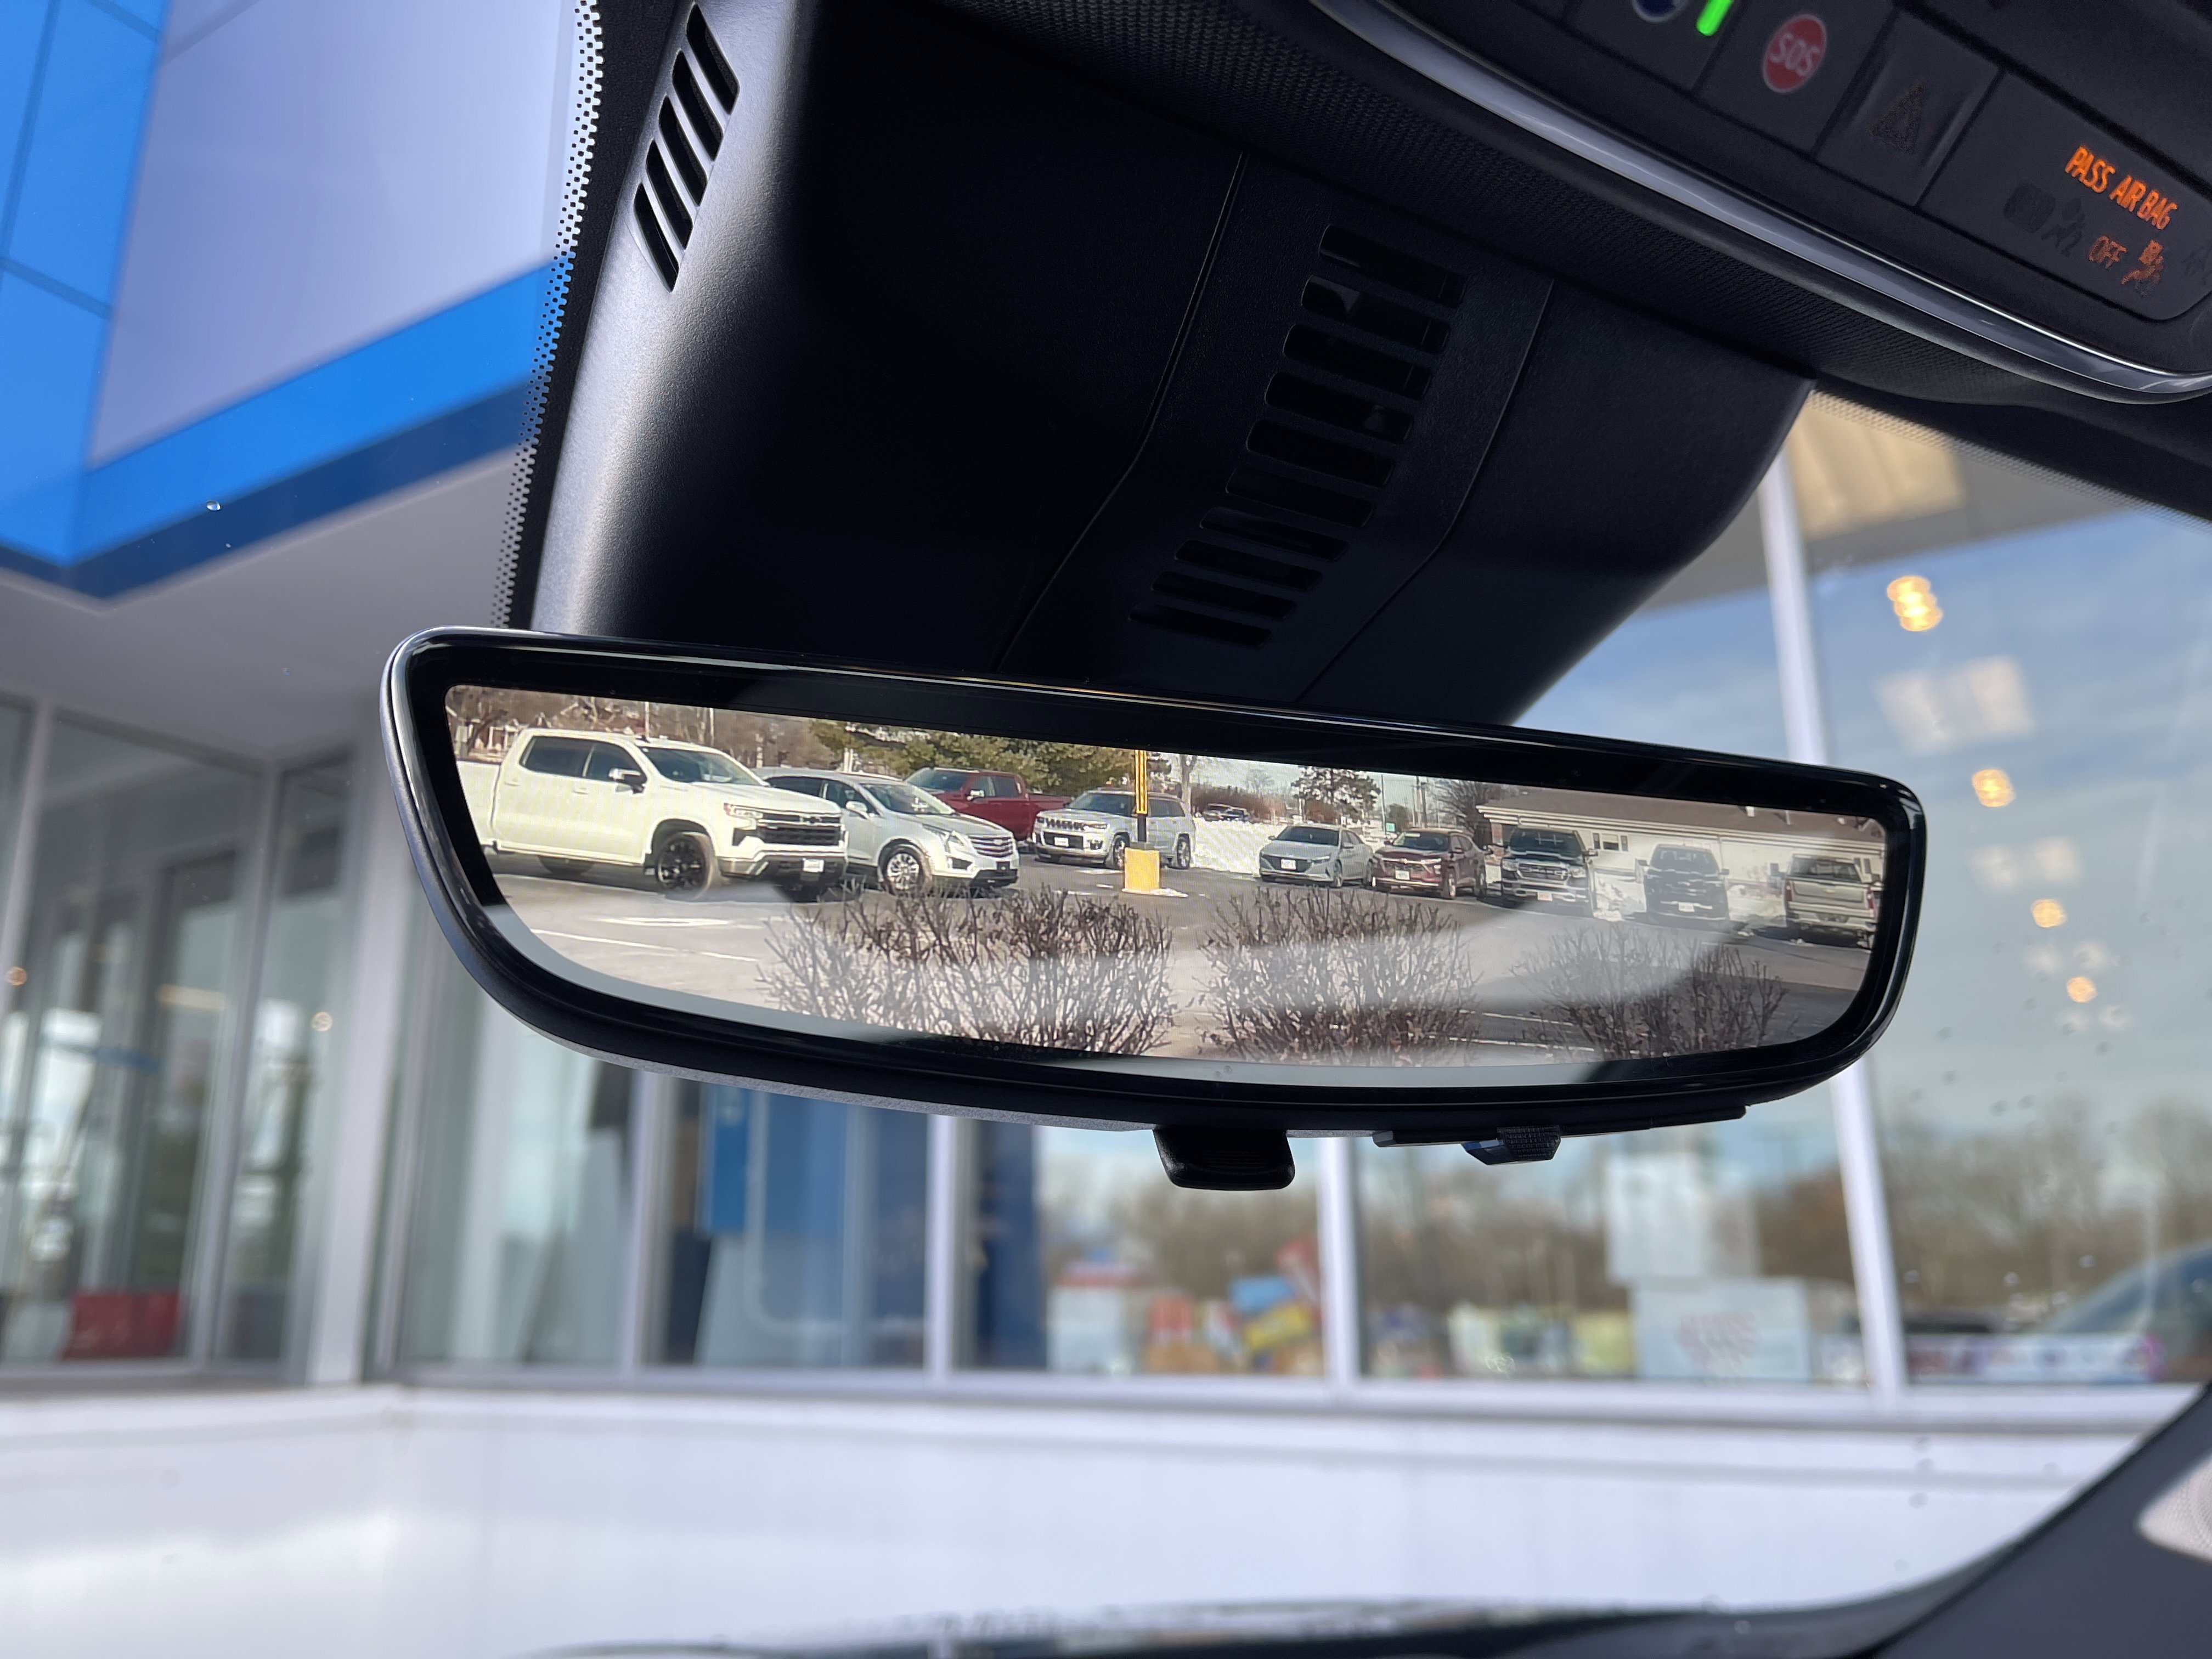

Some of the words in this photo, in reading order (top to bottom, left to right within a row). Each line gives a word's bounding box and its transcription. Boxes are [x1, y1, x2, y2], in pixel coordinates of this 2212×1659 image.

[1770, 33, 1820, 76] SOS
[2065, 146, 2115, 193] PASS
[2088, 236, 2128, 269] OFF
